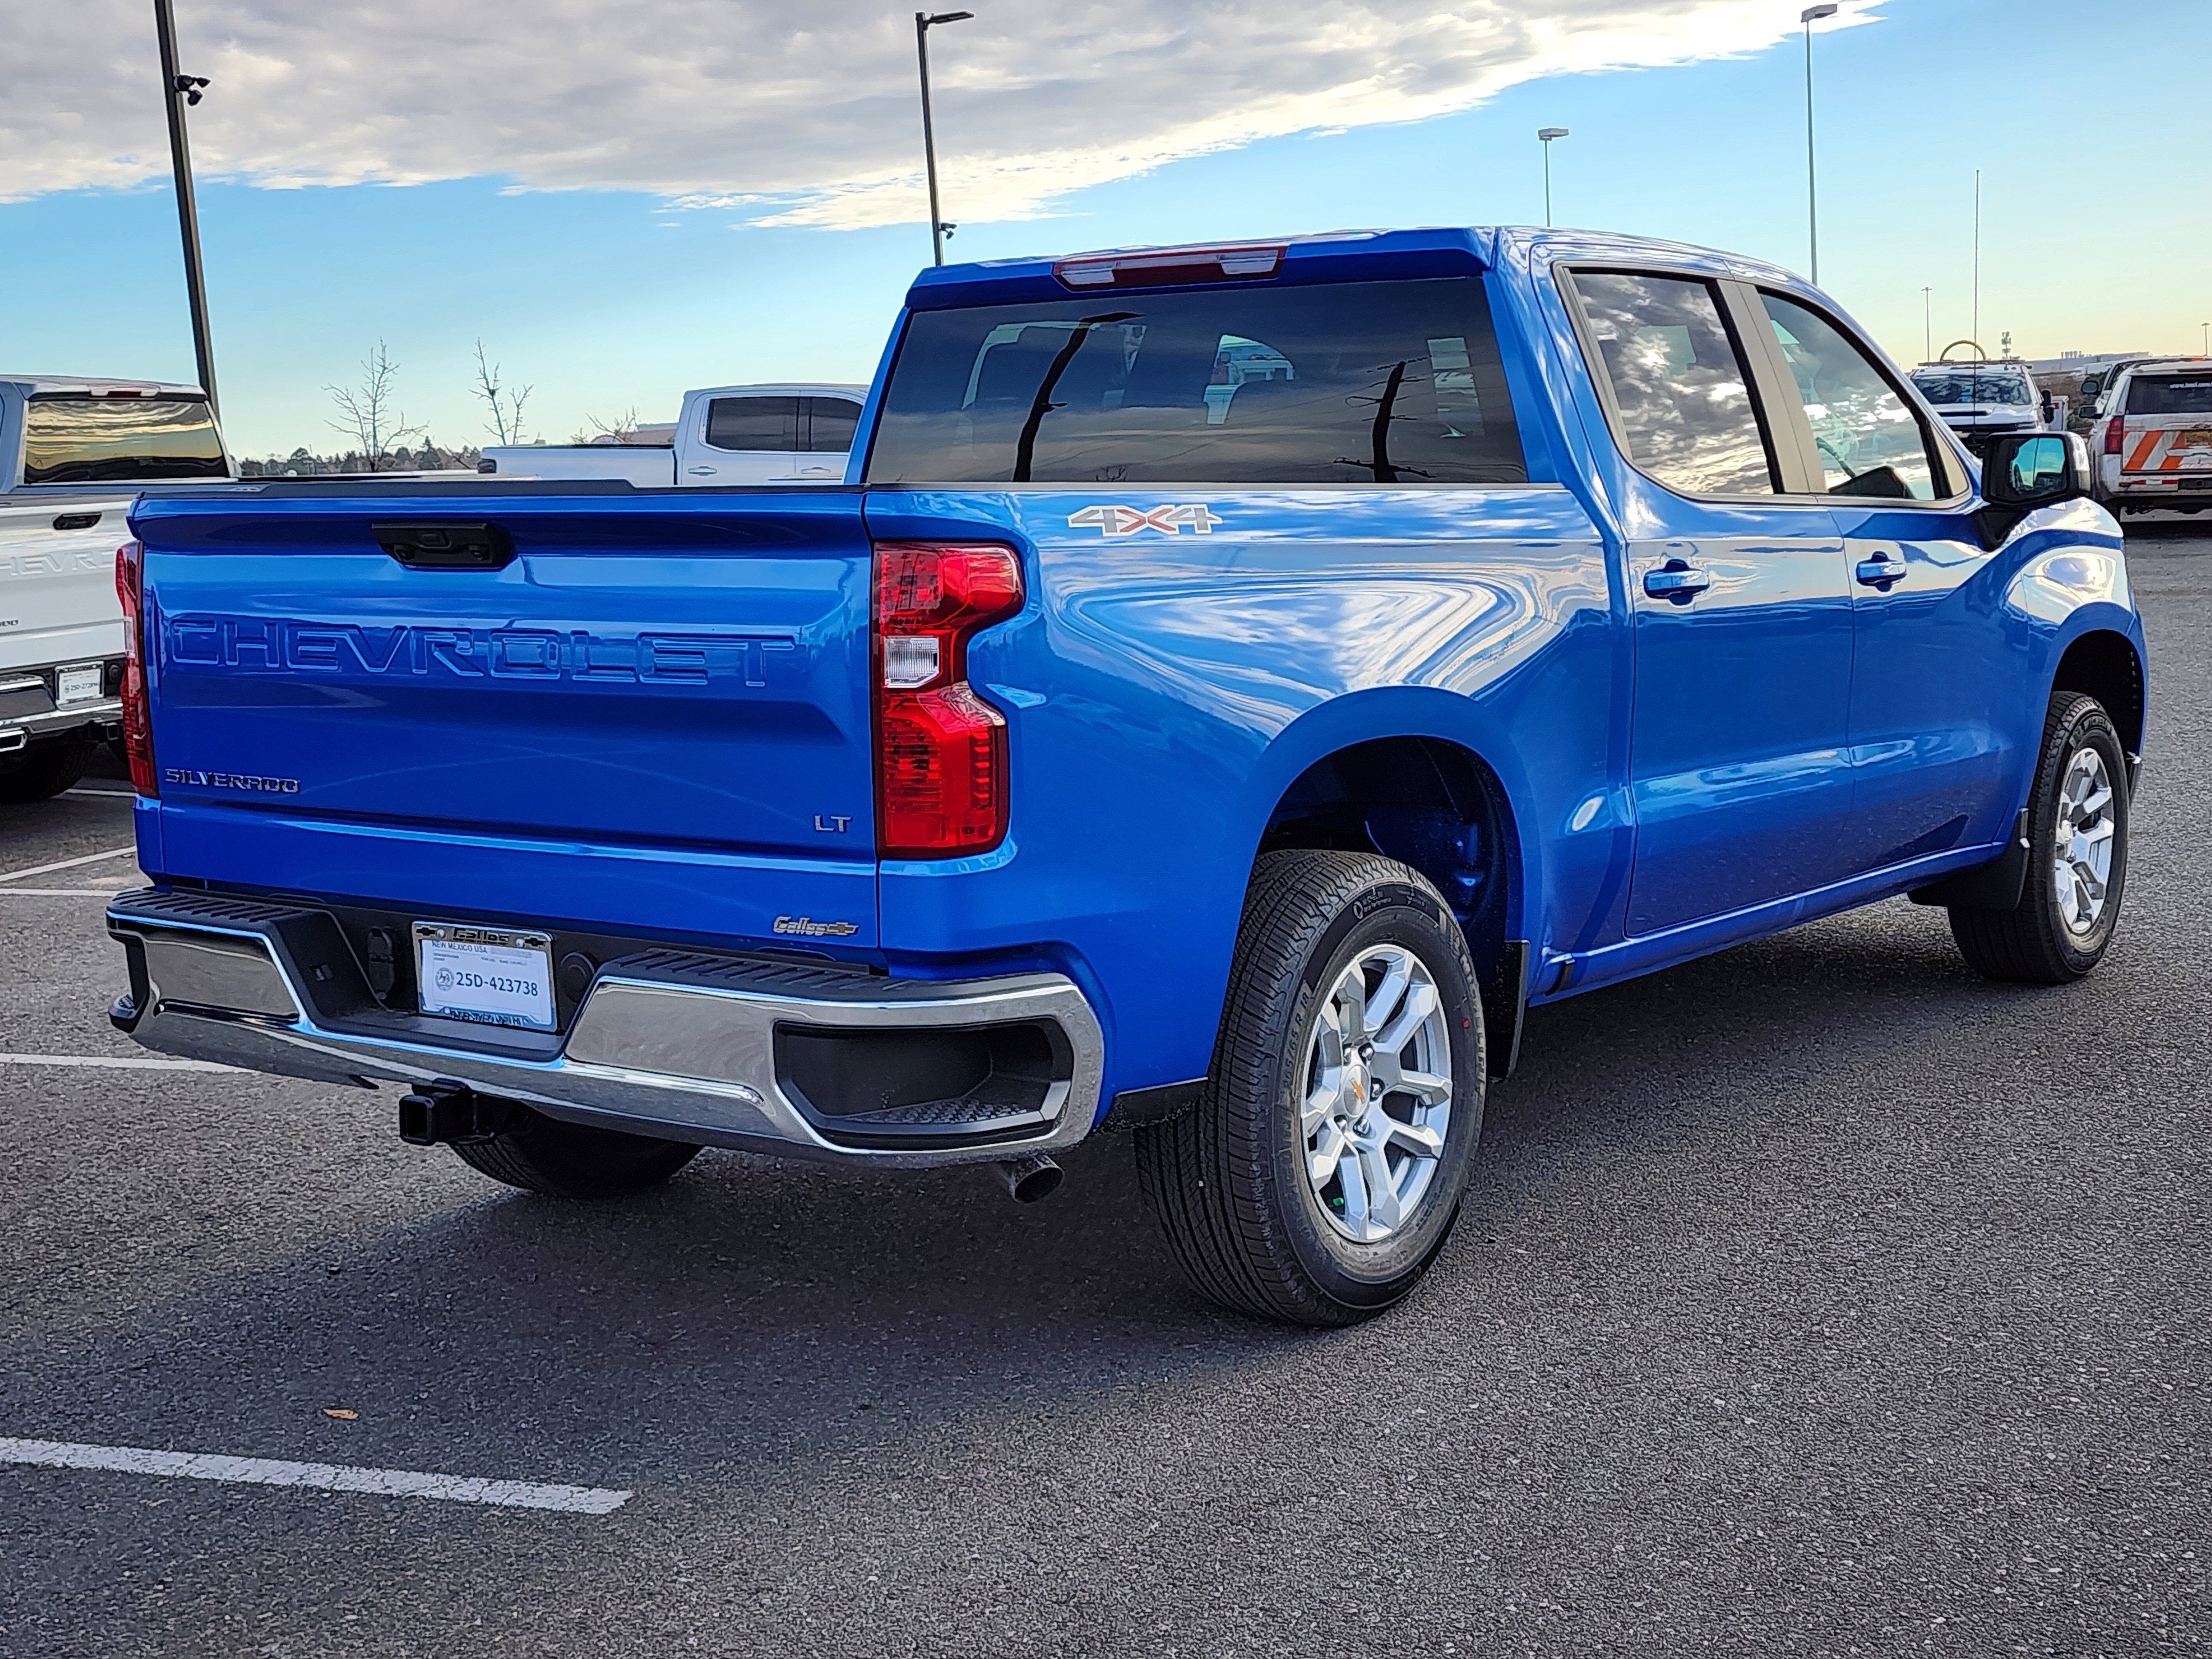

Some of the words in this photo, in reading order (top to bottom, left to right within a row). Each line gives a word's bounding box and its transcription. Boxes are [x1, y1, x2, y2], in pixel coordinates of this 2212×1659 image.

[171, 618, 795, 687] CHEVROLET
[165, 768, 301, 794] SILVERADO
[814, 815, 853, 833] LT
[773, 916, 826, 936] Galles
[431, 940, 446, 949] NEW
[448, 942, 473, 952] MEXICO
[456, 972, 539, 997] 25D-423738
